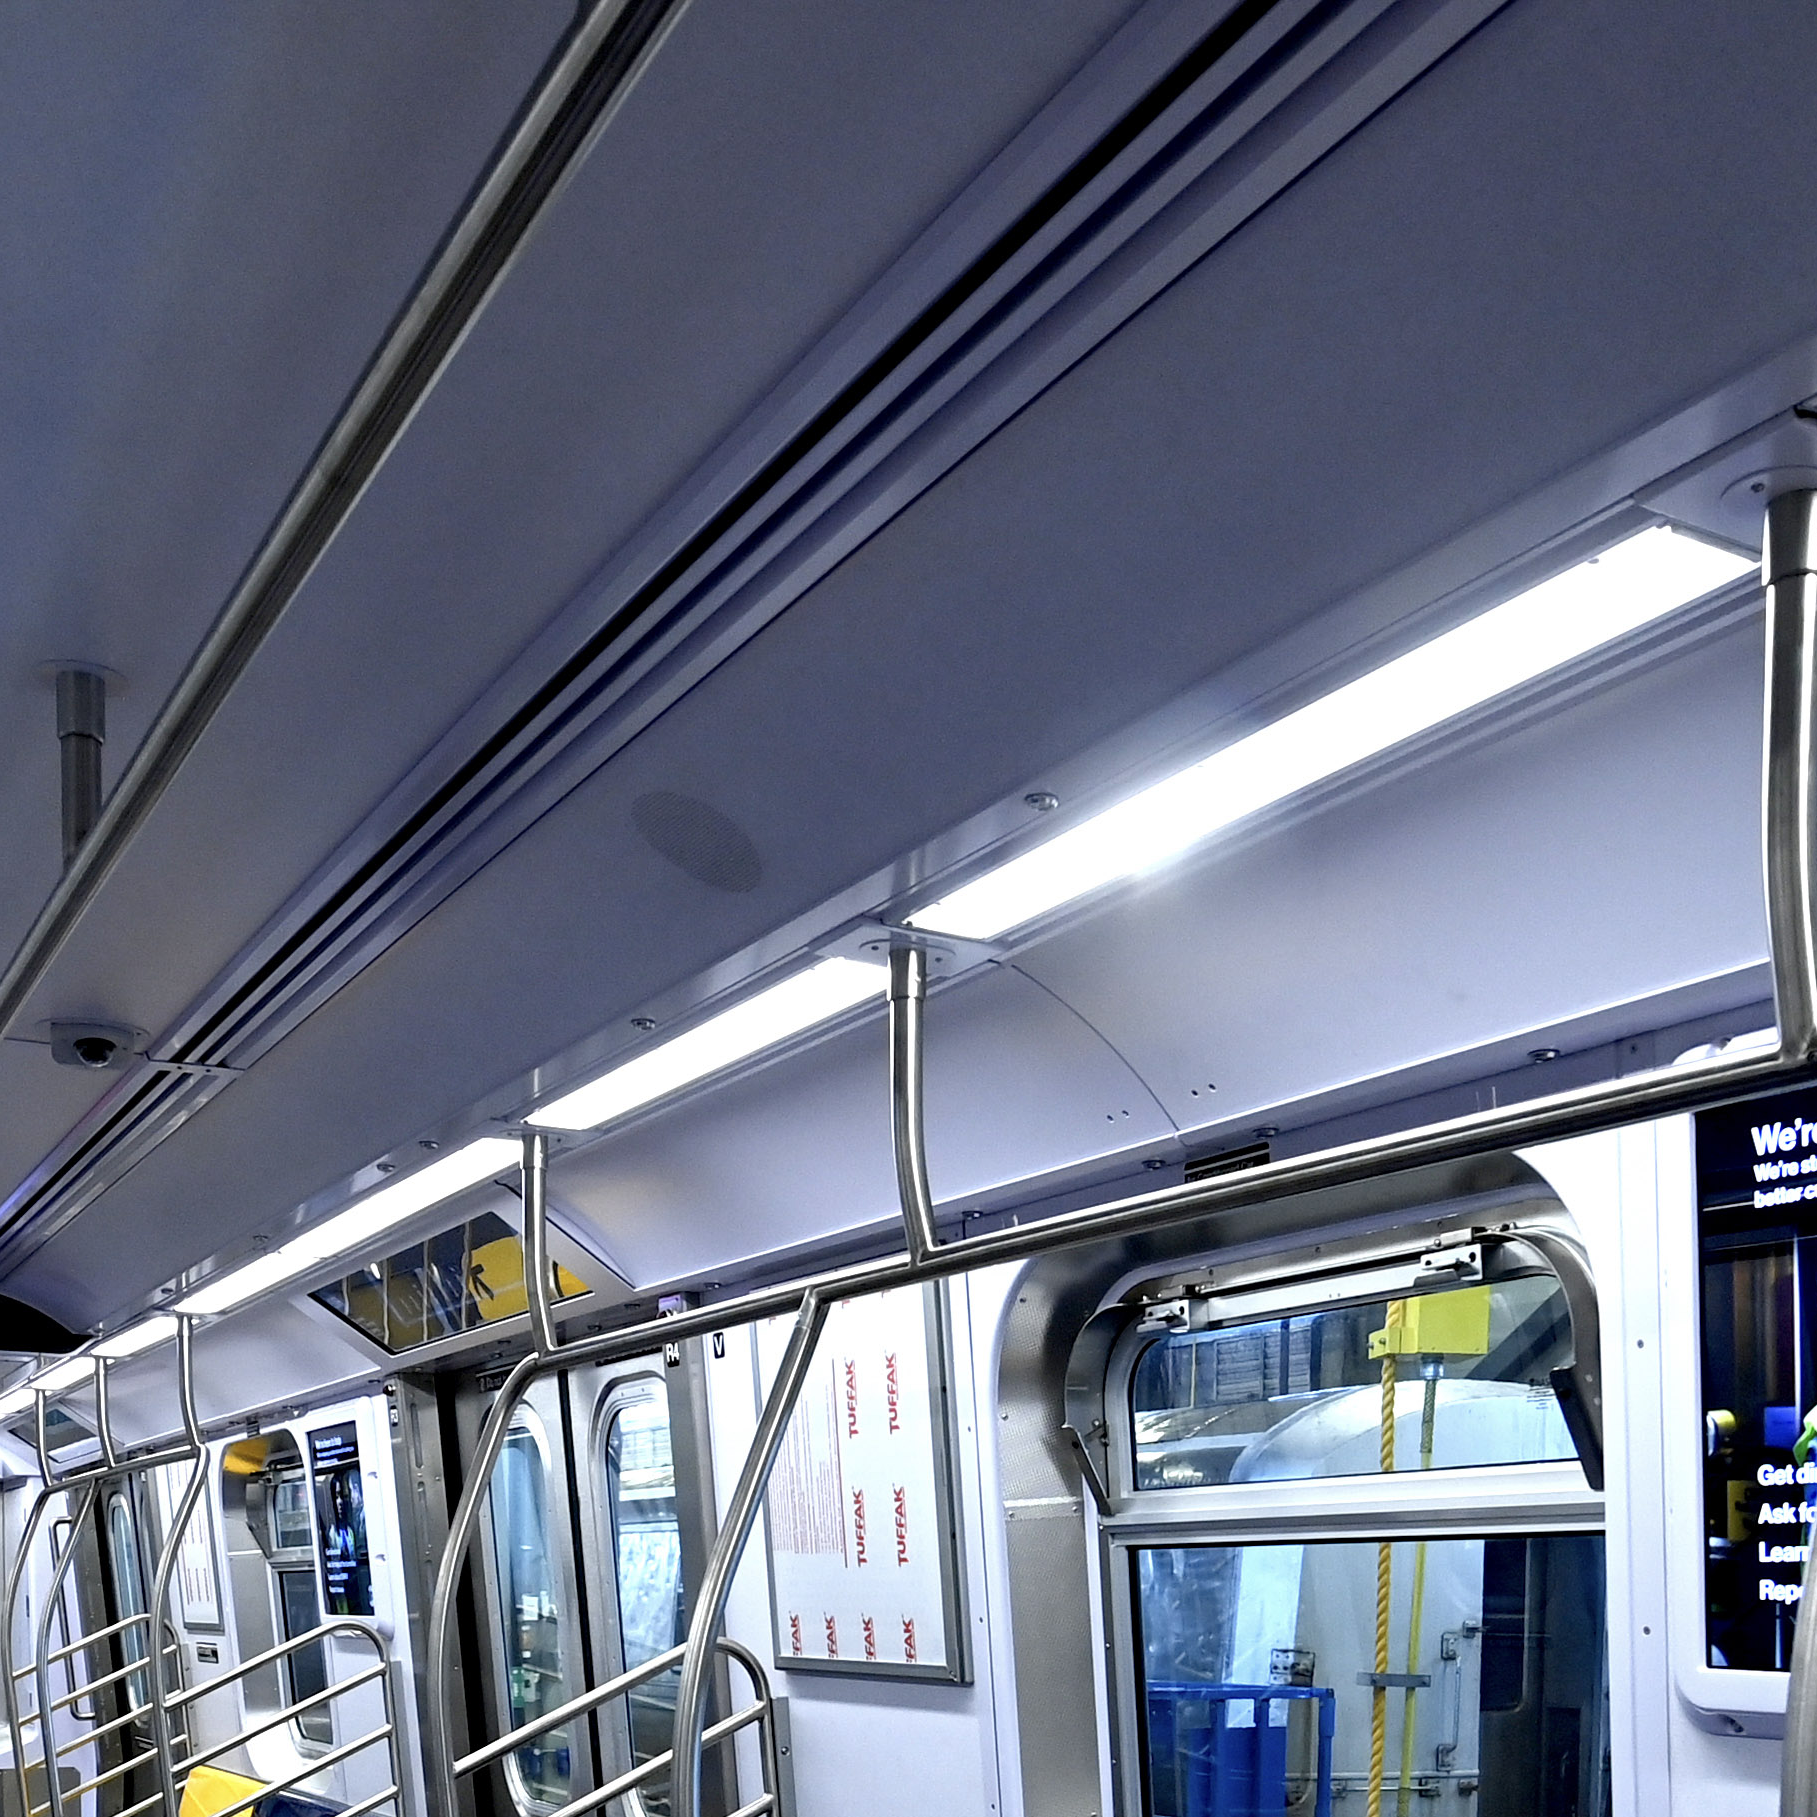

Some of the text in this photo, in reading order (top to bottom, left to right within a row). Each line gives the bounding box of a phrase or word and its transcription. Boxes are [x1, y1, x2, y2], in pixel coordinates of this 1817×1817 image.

[1753, 1160, 1799, 1182] We're
[1754, 1186, 1803, 1208] better
[666, 1342, 680, 1362] R4
[713, 1335, 723, 1356] V
[845, 1360, 859, 1439] TUFFAK
[885, 1352, 900, 1435] TUFFAK
[1757, 1464, 1794, 1487] Get
[1758, 1502, 1797, 1524] Ask
[853, 1489, 867, 1567] TUFFAK
[893, 1486, 909, 1567] TUFFAK
